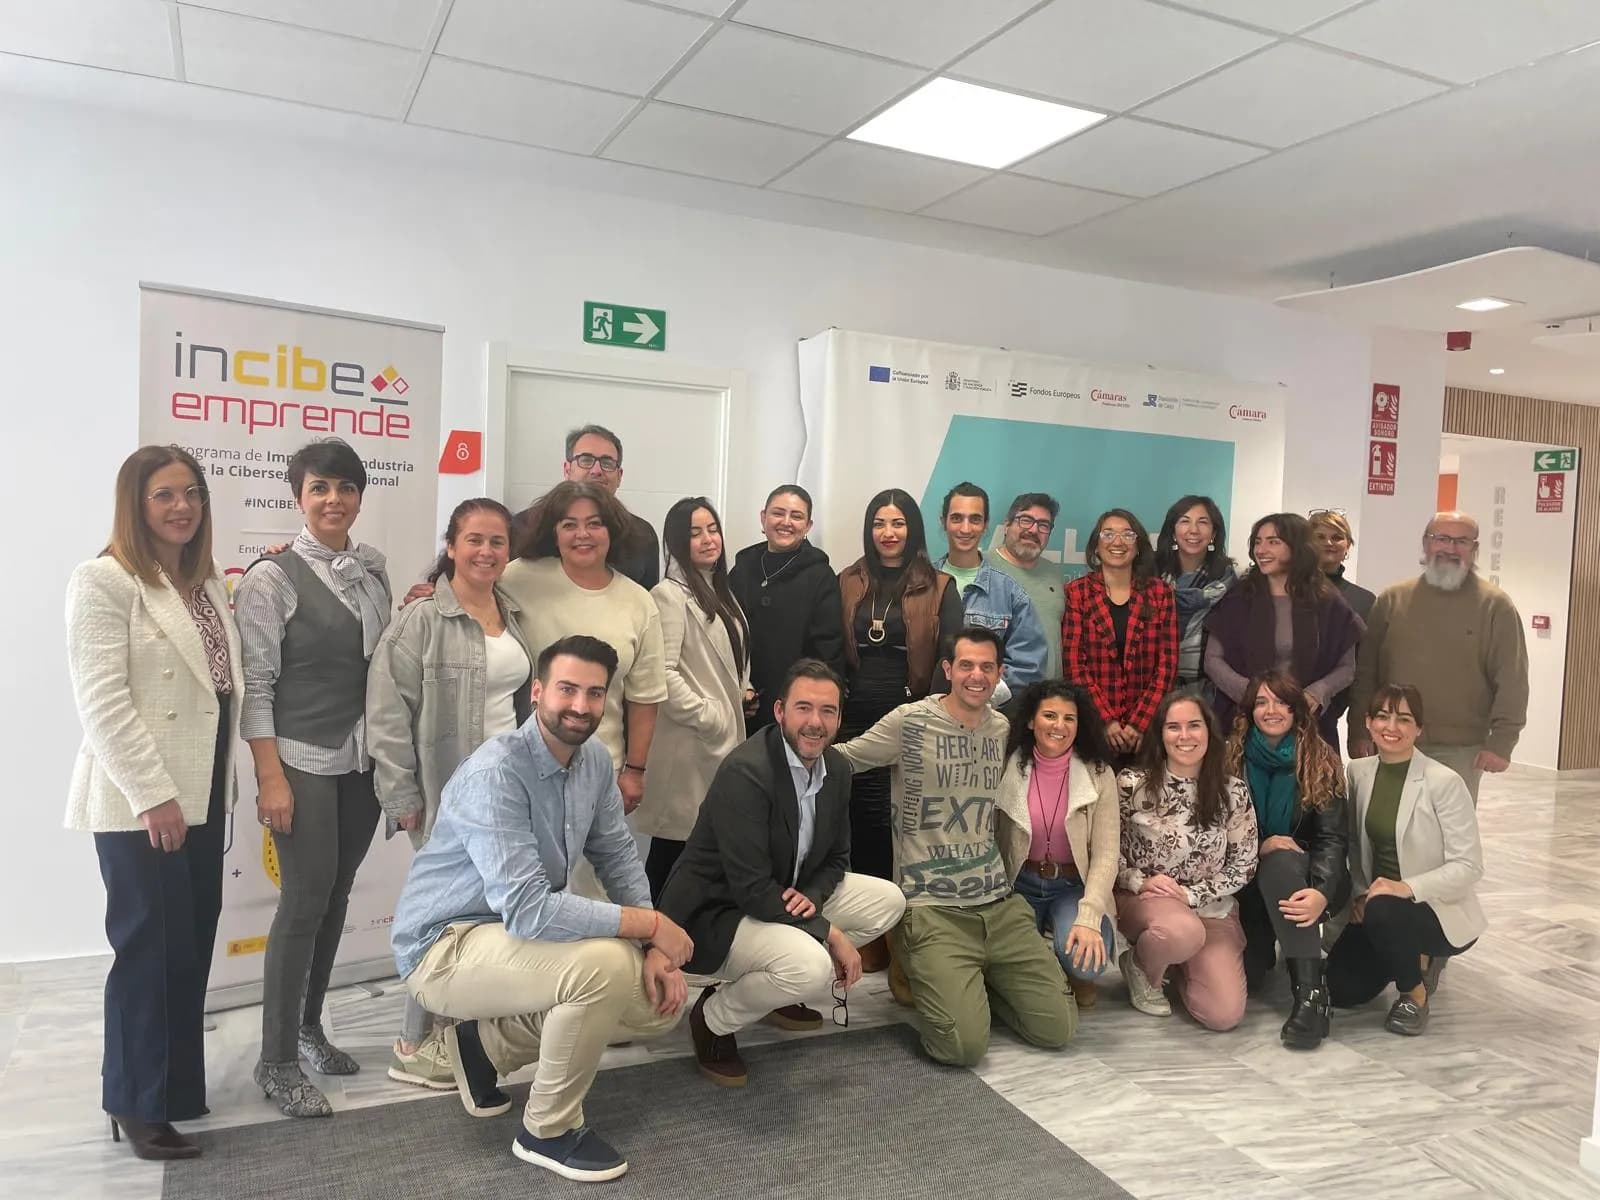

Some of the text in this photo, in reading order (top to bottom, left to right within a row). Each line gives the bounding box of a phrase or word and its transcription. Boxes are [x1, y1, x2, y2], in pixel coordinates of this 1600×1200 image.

[175, 331, 365, 397] incibe
[1030, 387, 1081, 400] Fondos Europeos
[1090, 389, 1127, 402] Cámaras
[171, 391, 410, 440] emprende
[1229, 404, 1267, 420] Cámara
[171, 443, 241, 461] ograma
[245, 448, 263, 461] de
[361, 458, 414, 472] ndustria
[211, 463, 224, 476] la
[1368, 482, 1395, 492] EXTINTOR
[903, 720, 926, 775] NORMAL
